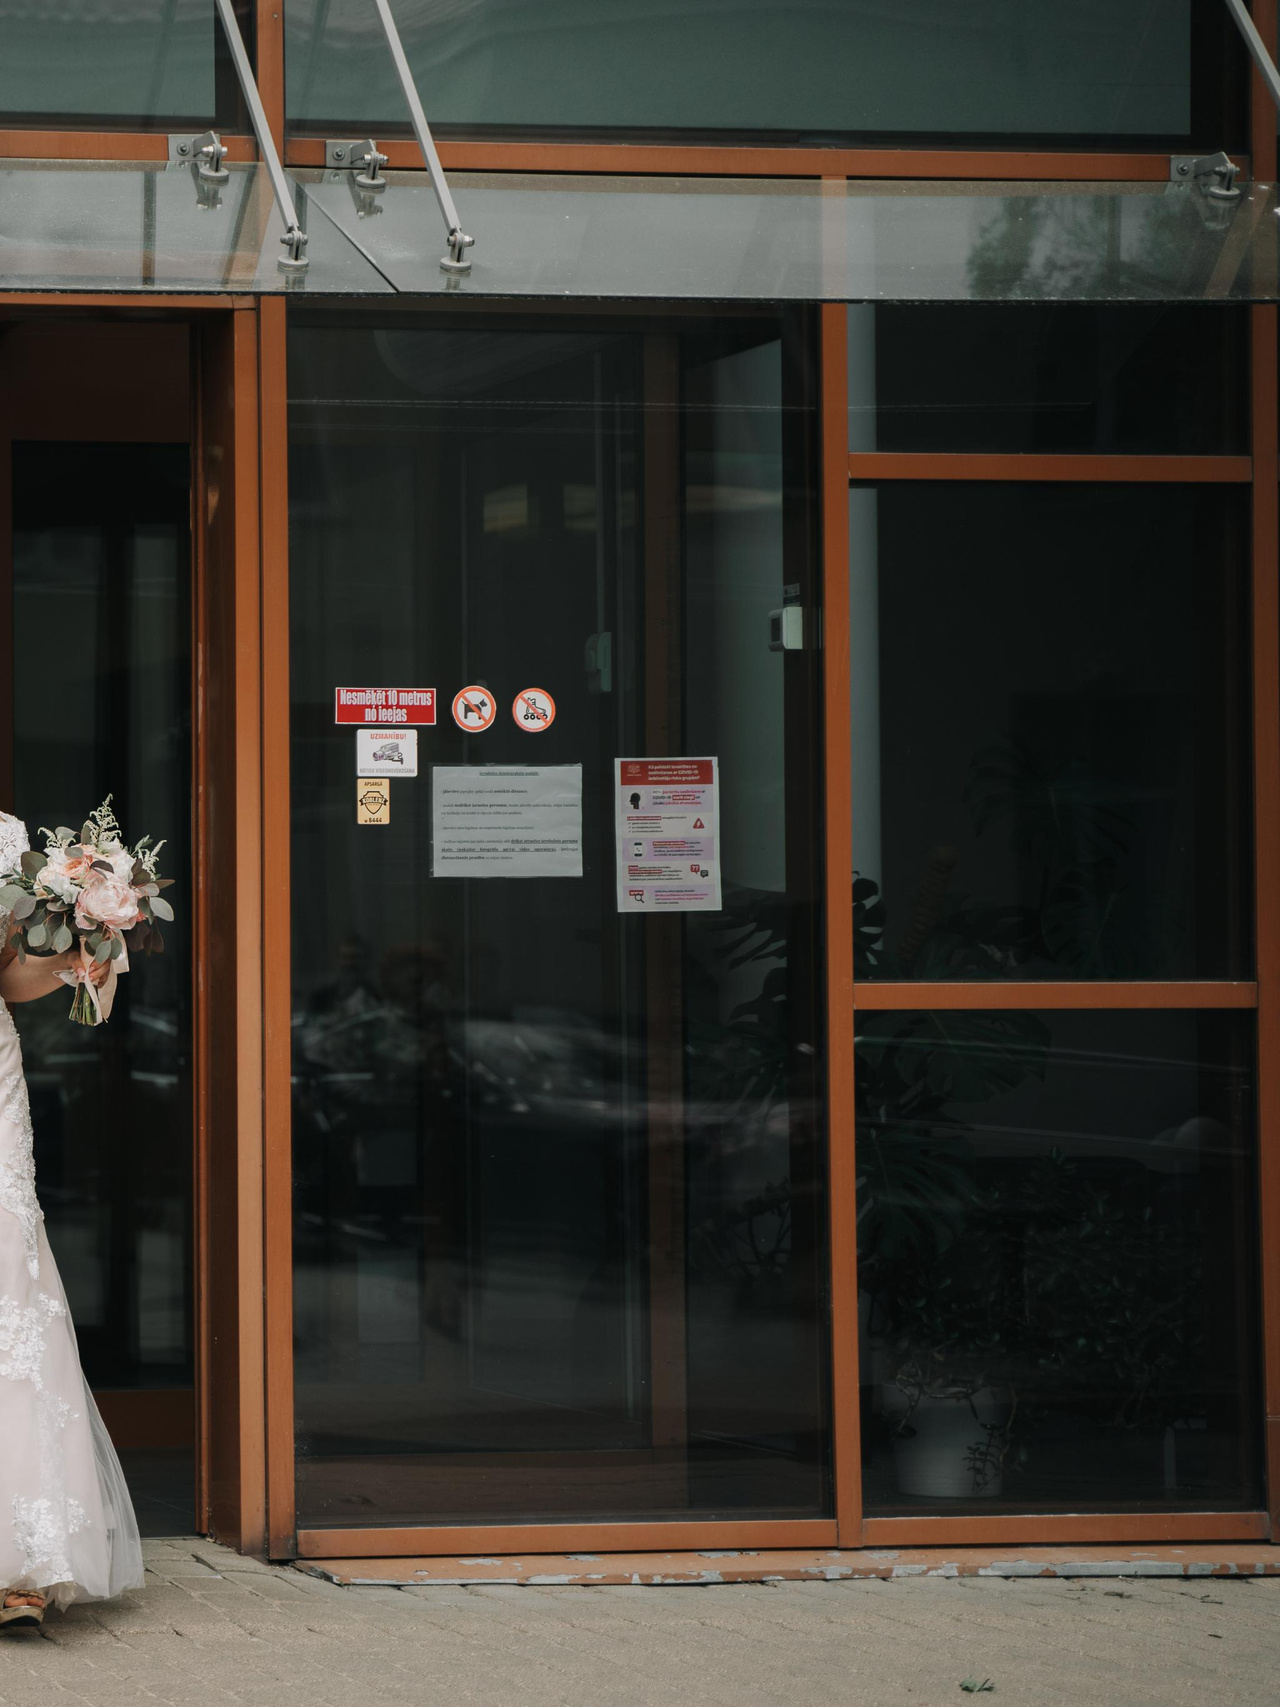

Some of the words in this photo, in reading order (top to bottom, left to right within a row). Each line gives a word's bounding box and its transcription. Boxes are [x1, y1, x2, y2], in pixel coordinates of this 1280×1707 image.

[387, 690, 397, 705] 10
[399, 691, 432, 705] metrus
[379, 706, 407, 722] ieejas
[370, 732, 407, 740] UZMANĪBU!
